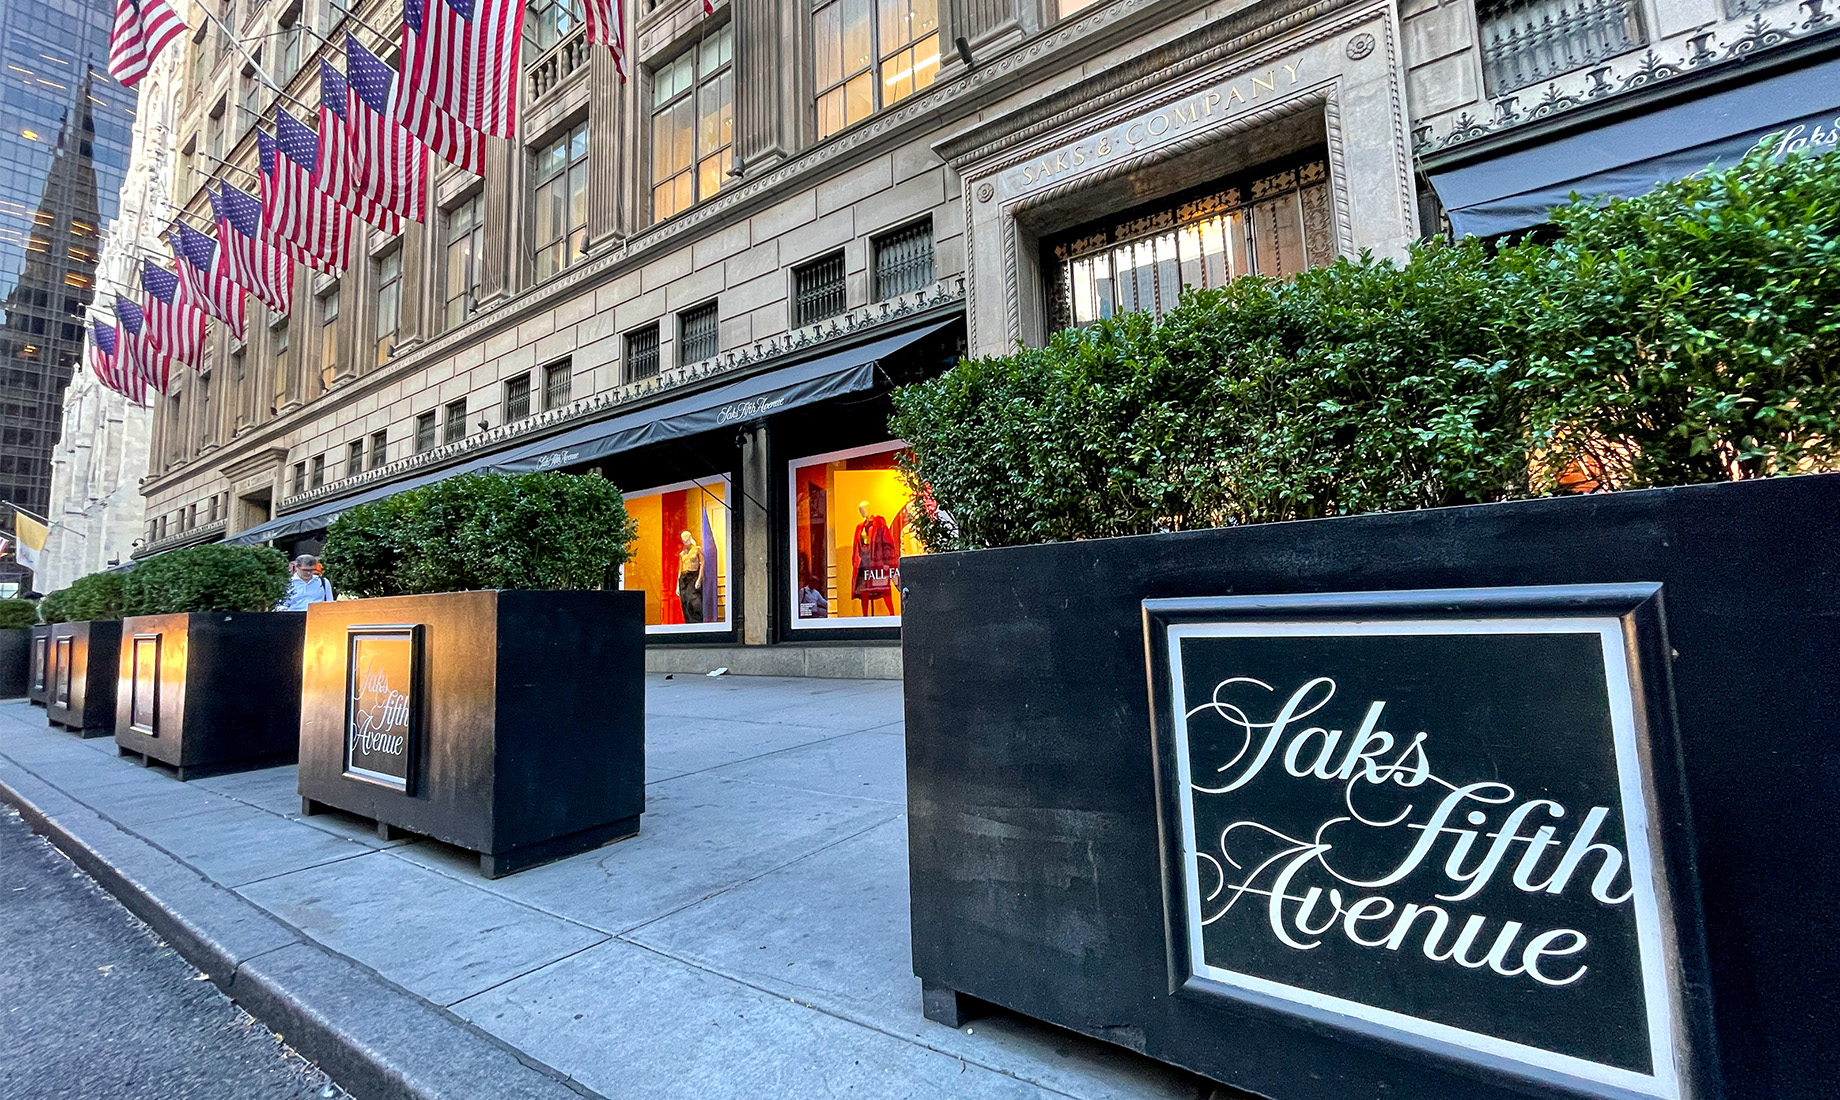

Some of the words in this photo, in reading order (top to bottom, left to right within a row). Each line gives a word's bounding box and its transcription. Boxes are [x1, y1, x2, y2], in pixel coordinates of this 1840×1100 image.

[1021, 146, 1086, 187] SAKS
[1097, 135, 1112, 158] &
[1125, 57, 1305, 146] COMPANY
[864, 568, 887, 581] FALL
[353, 710, 404, 756] Avenue
[354, 655, 389, 700] Saks
[1185, 676, 1430, 793] Saks
[1317, 770, 1635, 904] Fifth
[1197, 820, 1588, 986] Avenue
